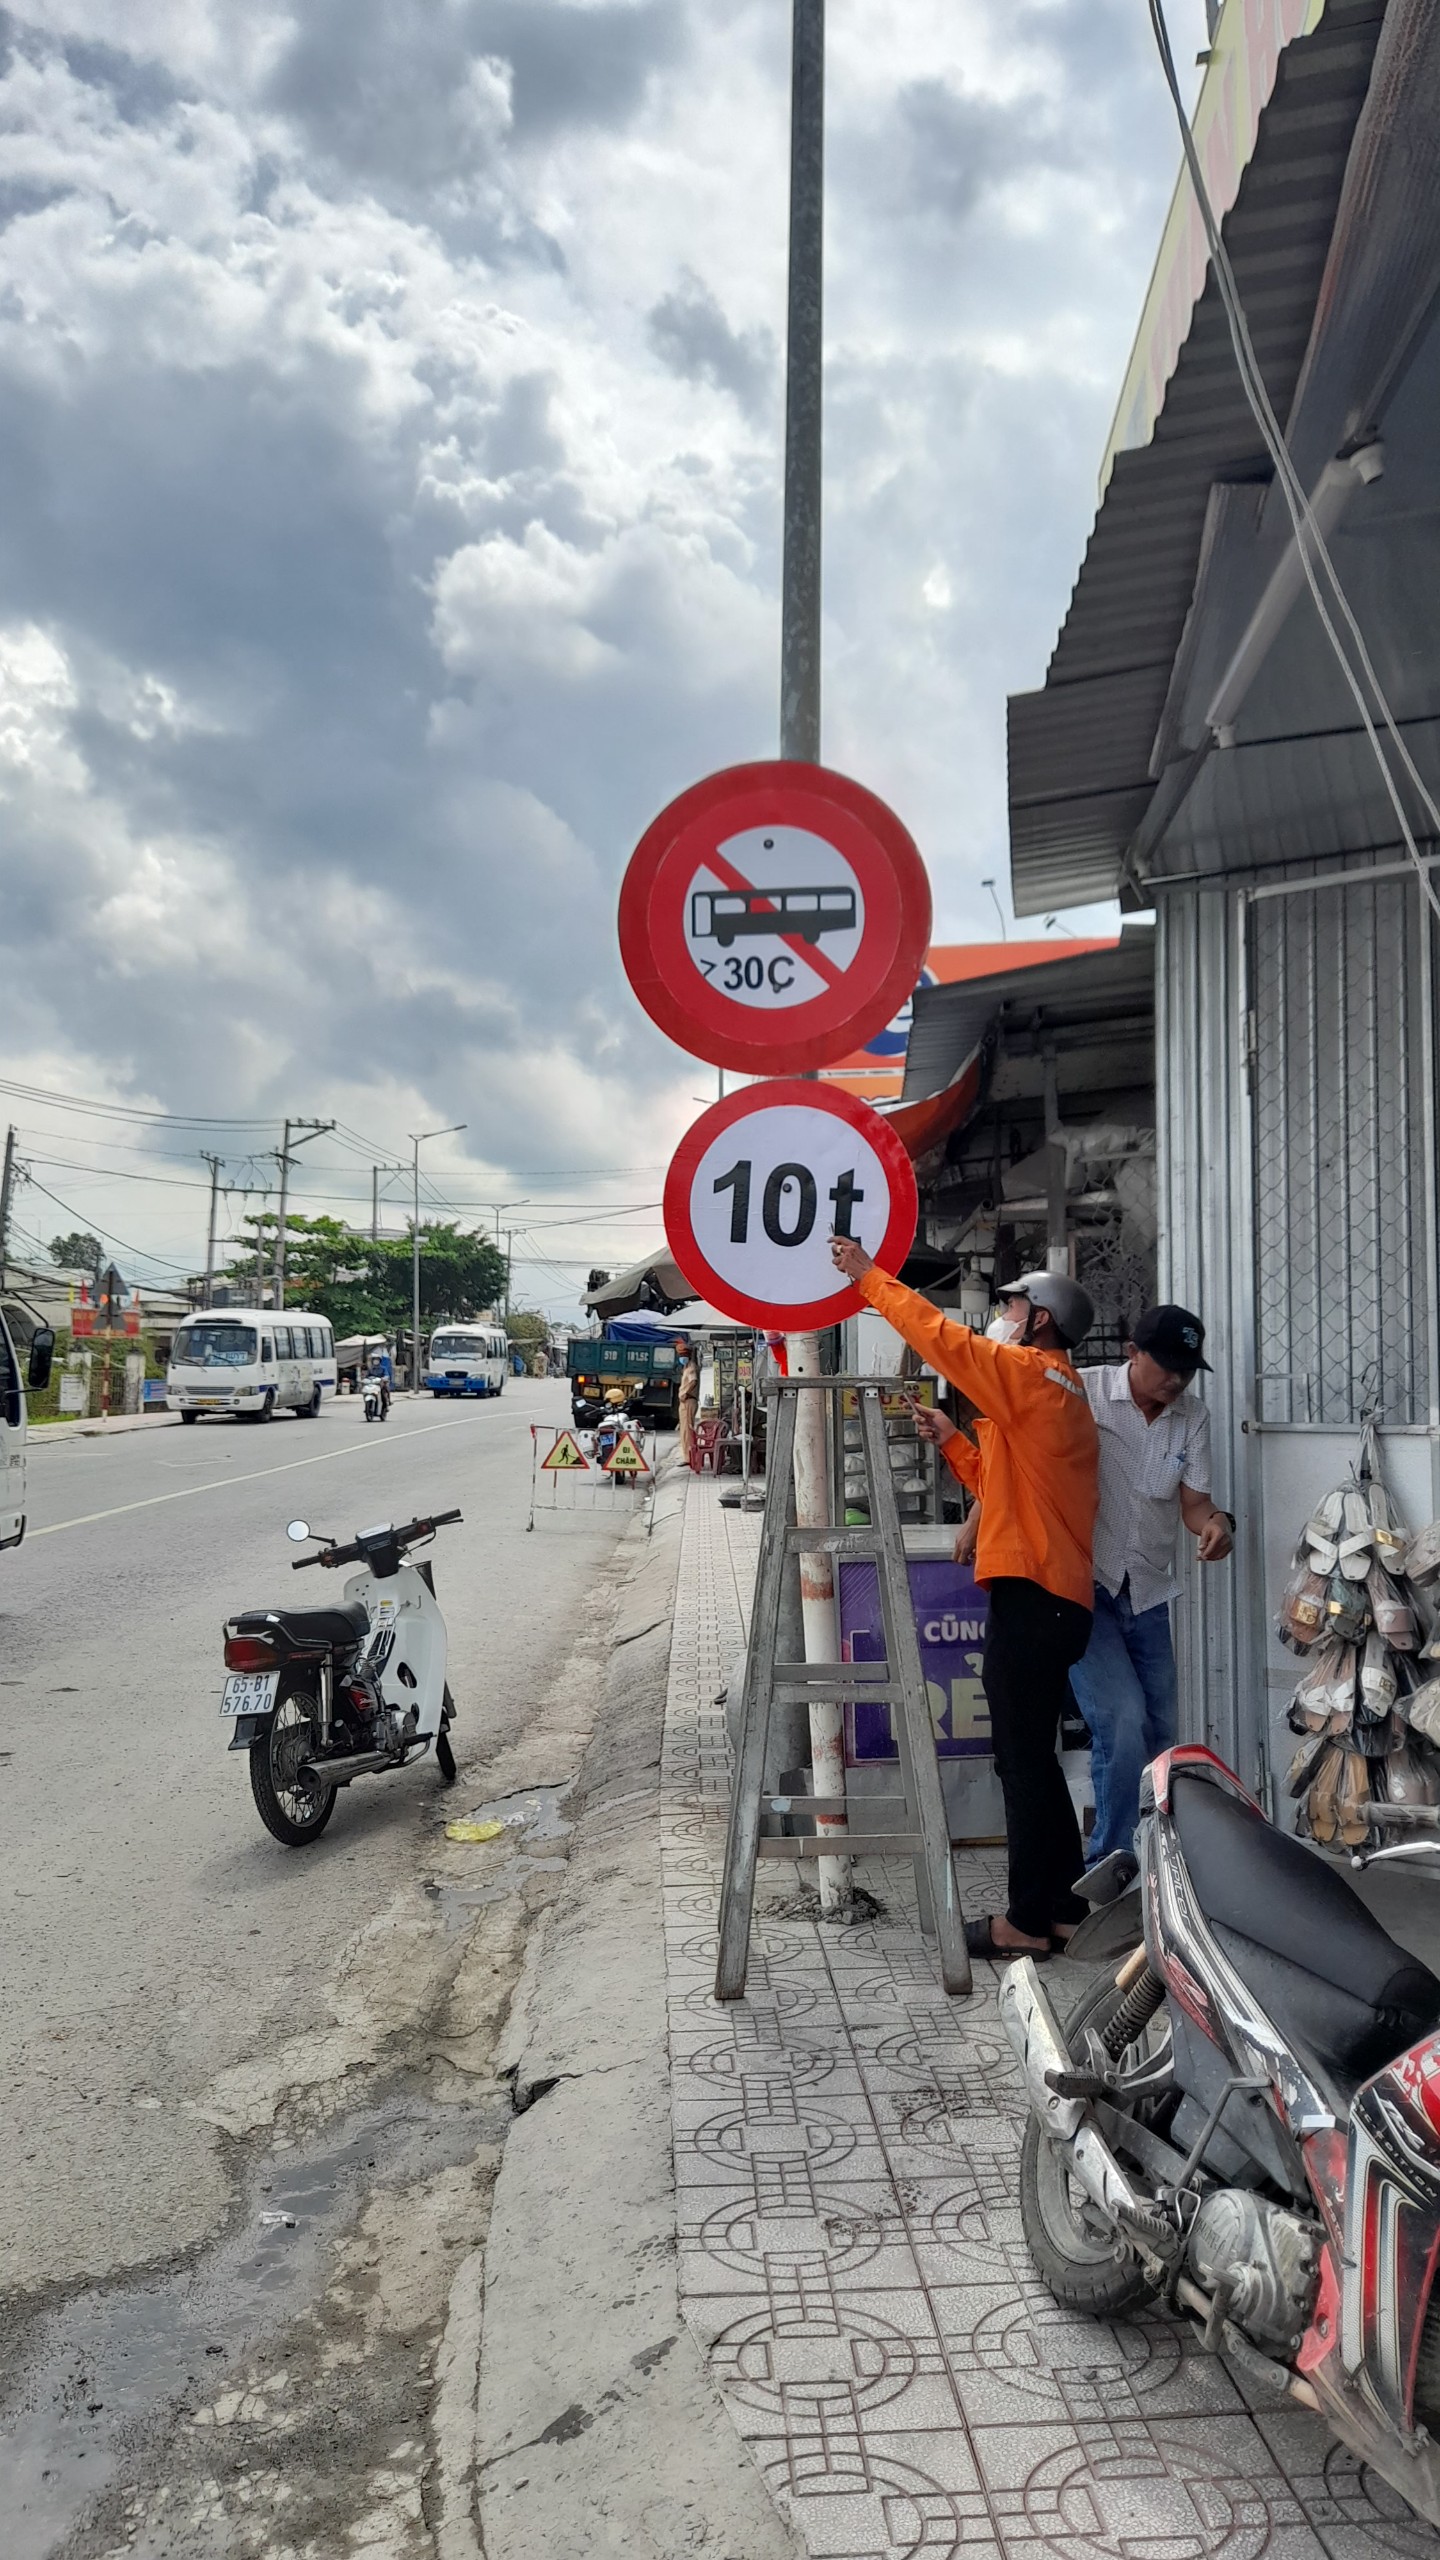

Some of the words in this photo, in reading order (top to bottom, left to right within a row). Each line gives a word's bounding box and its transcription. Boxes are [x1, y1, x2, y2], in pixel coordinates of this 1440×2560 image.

[713, 1160, 865, 1248] 10t
[232, 1674, 270, 1694] 65-B1
[223, 1693, 272, 1713] 576.70
